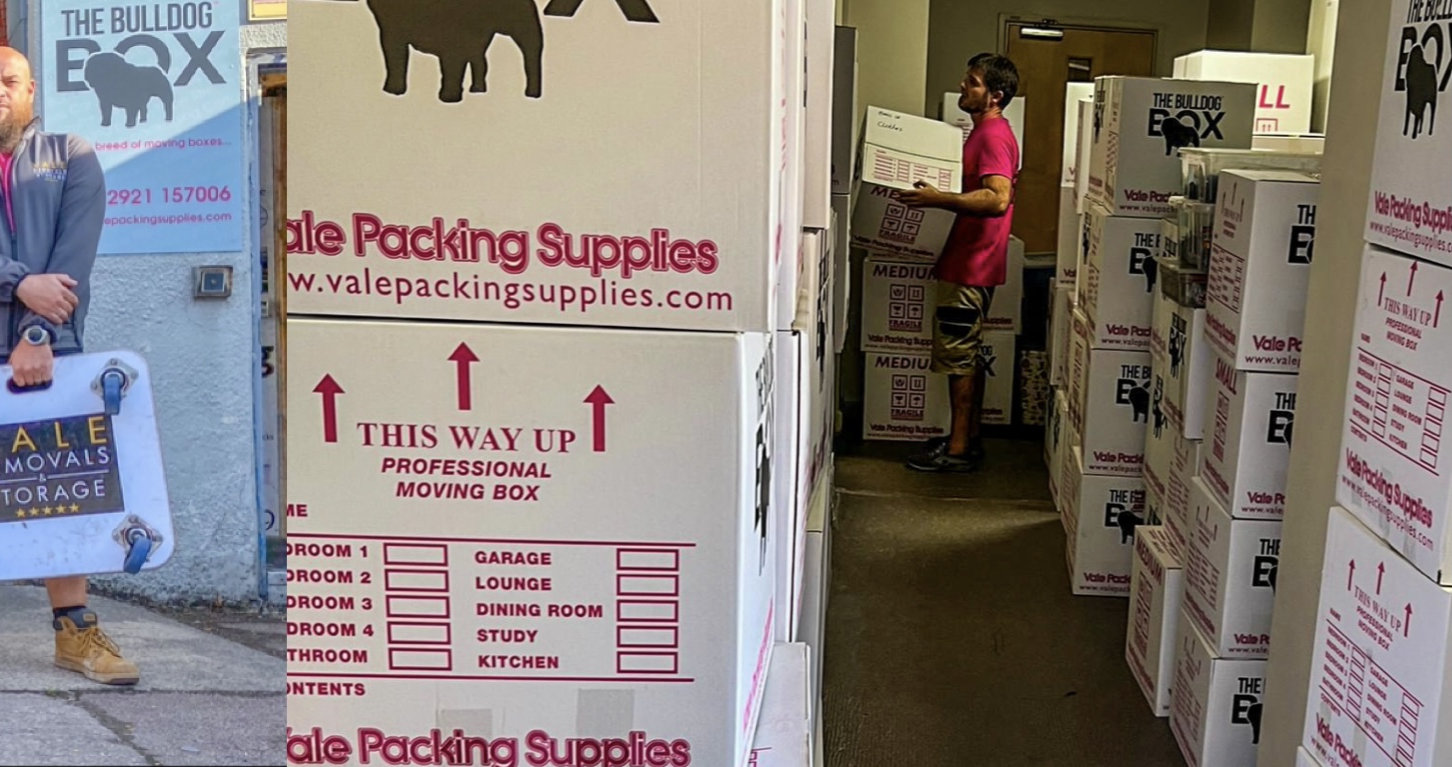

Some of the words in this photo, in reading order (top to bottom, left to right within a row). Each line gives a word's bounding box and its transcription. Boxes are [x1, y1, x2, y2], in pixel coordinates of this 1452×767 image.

[61, 8, 105, 36] THE
[110, 2, 213, 33] BULLDOG
[1153, 93, 1174, 109] THE
[1175, 94, 1222, 111] BULLDOG
[131, 139, 141, 149] of
[144, 138, 186, 151] moving
[107, 187, 152, 205] 2921
[163, 186, 232, 204] 157006
[1124, 189, 1148, 202] Vale
[1374, 190, 1389, 217] Vale
[1390, 194, 1422, 229] Packing
[104, 211, 232, 226] epackingsupplies.com
[352, 213, 530, 274] Packing
[536, 222, 719, 279] Supplies
[1134, 233, 1154, 248] THE
[1384, 296, 1401, 316] THIS
[1401, 304, 1420, 324] WAY
[1420, 311, 1432, 327] UP
[1106, 324, 1129, 336] Vale
[1384, 316, 1422, 339] PROFESSIONAL
[884, 335, 913, 346] Packing
[1252, 335, 1286, 351] Vale
[1385, 330, 1406, 347] MOVING
[1405, 338, 1418, 351] BOX
[1121, 365, 1141, 379] THE
[887, 424, 914, 434] Packing
[356, 421, 438, 449] THIS
[449, 424, 524, 453] WAY
[533, 428, 577, 454] UP
[1093, 451, 1117, 463] Vale
[380, 457, 552, 479] PROFESSIONAL
[396, 481, 486, 500] MOVING
[492, 483, 541, 502] BOX
[1346, 447, 1362, 478] Vale
[1361, 460, 1394, 506] Packing
[1394, 483, 1433, 528] Supplies
[1109, 489, 1129, 503] THE
[1248, 491, 1271, 505] Vale
[359, 545, 369, 559] 1
[474, 550, 553, 566] GARAGE
[360, 571, 372, 585] 2
[475, 576, 553, 592] LOUNGE
[1083, 572, 1106, 584] Vale
[361, 597, 373, 612] 3
[476, 602, 541, 618] DINING
[548, 604, 604, 619] ROOM
[1353, 584, 1371, 608] THIS
[1372, 597, 1390, 621] WAY
[1389, 613, 1402, 632] UP
[287, 622, 357, 637] DROOM
[362, 624, 375, 638] 4
[1356, 605, 1394, 642] PROFESSIONAL
[476, 628, 538, 643] STUDY
[1234, 634, 1259, 646] Vale
[1357, 619, 1378, 642] MOVING
[1377, 634, 1391, 652] BOX
[478, 655, 560, 670] KITCHEN
[1369, 666, 1389, 688] GARAGE
[1237, 677, 1261, 694] THE
[1368, 679, 1387, 701] LOUNGE
[1316, 711, 1335, 747] Vale
[525, 729, 692, 767] Supplies
